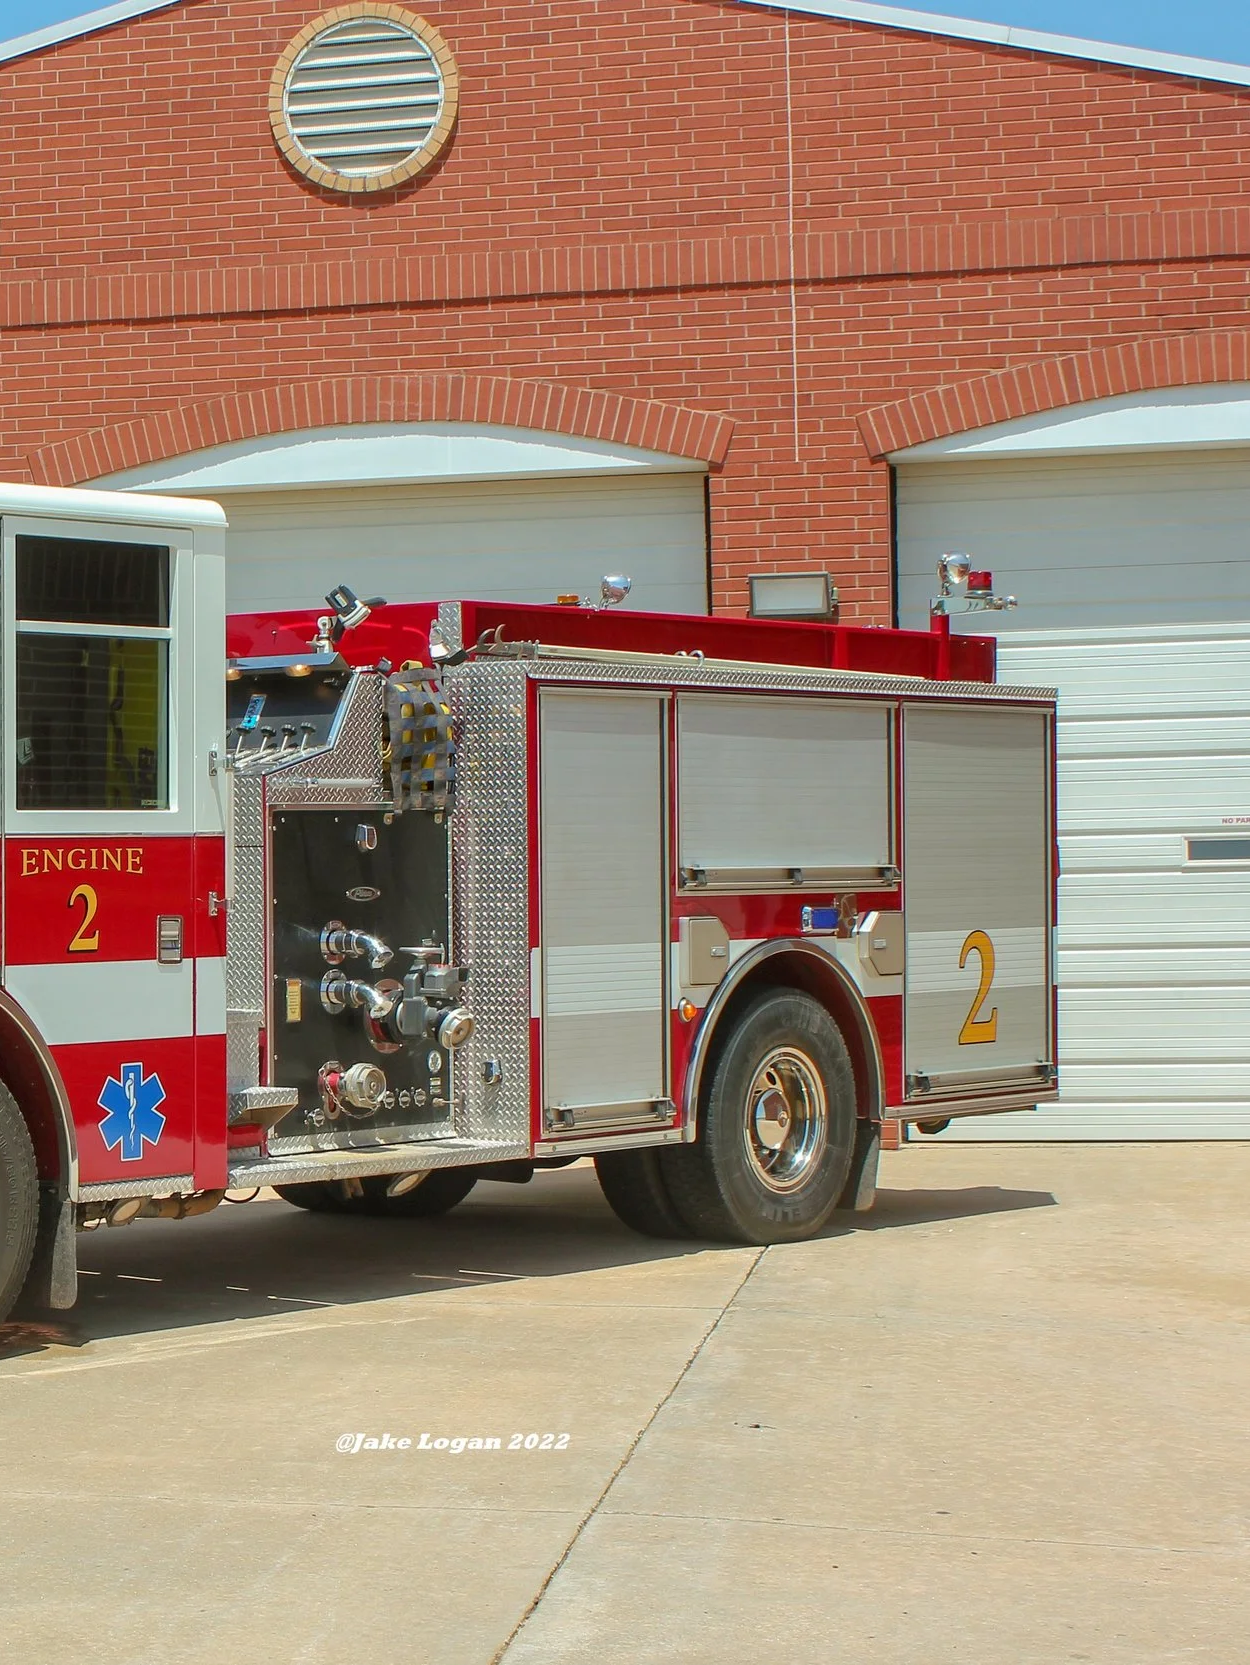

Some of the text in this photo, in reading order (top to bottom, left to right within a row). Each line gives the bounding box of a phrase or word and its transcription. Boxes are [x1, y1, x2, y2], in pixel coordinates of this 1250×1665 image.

[1221, 817, 1234, 825] NO
[20, 847, 144, 876] ENGINE
[67, 883, 100, 954] 2
[958, 929, 998, 1046] 2
